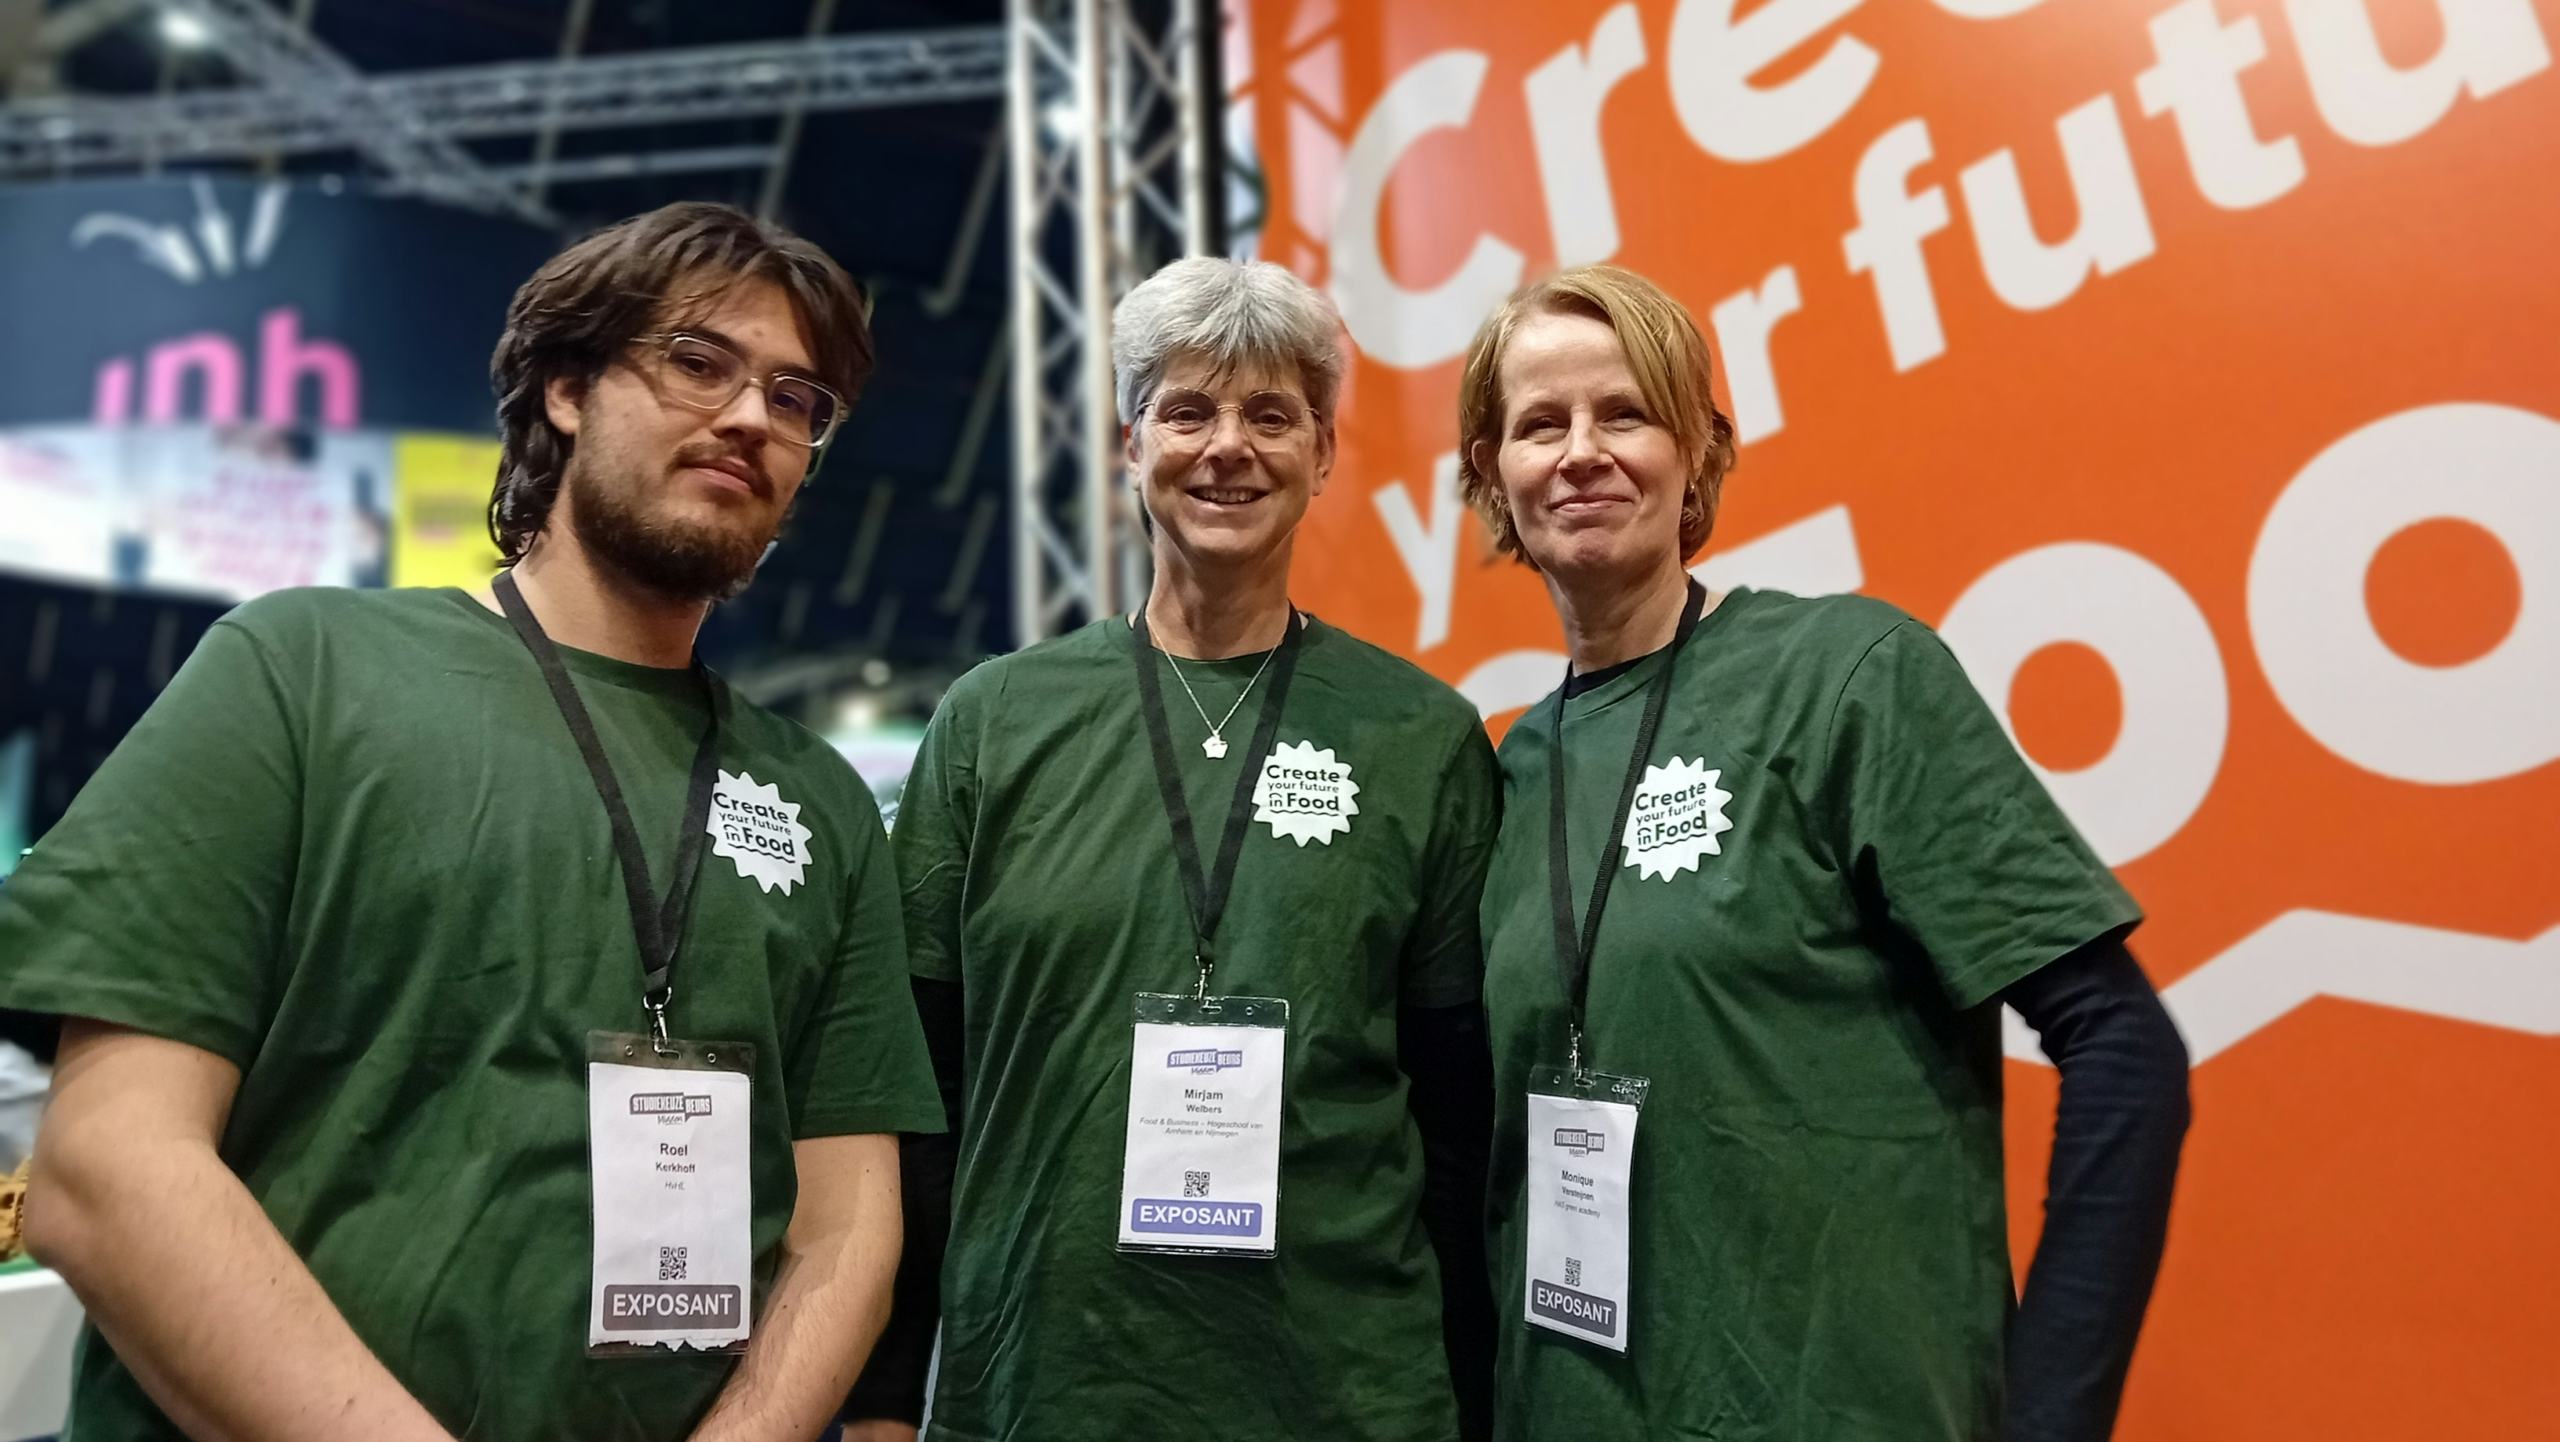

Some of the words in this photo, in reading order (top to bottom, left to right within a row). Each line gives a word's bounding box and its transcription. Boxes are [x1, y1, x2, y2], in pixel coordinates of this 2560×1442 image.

[1328, 0, 2055, 370] Cre
[1372, 265, 1803, 653] yr
[1266, 764, 1340, 782] Create
[1267, 782, 1296, 791] your
[1299, 781, 1339, 793] future
[1635, 782, 1707, 811] Create
[713, 792, 789, 824] Create
[1269, 796, 1283, 808] in
[1287, 793, 1339, 811] Food
[1636, 811, 1665, 826] your
[1668, 799, 1707, 817] future
[719, 812, 749, 825] your
[752, 816, 792, 837] future
[1637, 832, 1652, 846] in
[1655, 810, 1708, 841] Food
[742, 827, 796, 857] Food
[1184, 1088, 1224, 1102] Mirjam
[1186, 1104, 1223, 1114] Welbers
[1139, 1117, 1158, 1126] Food
[660, 1142, 688, 1157] Roel
[656, 1161, 696, 1174] Kerkhoff
[1561, 1169, 1595, 1187] Monique
[1138, 1204, 1255, 1228] EXPOSANT
[611, 1292, 734, 1318] EXPOSANT
[1536, 1286, 1613, 1326] EXPOSANT
